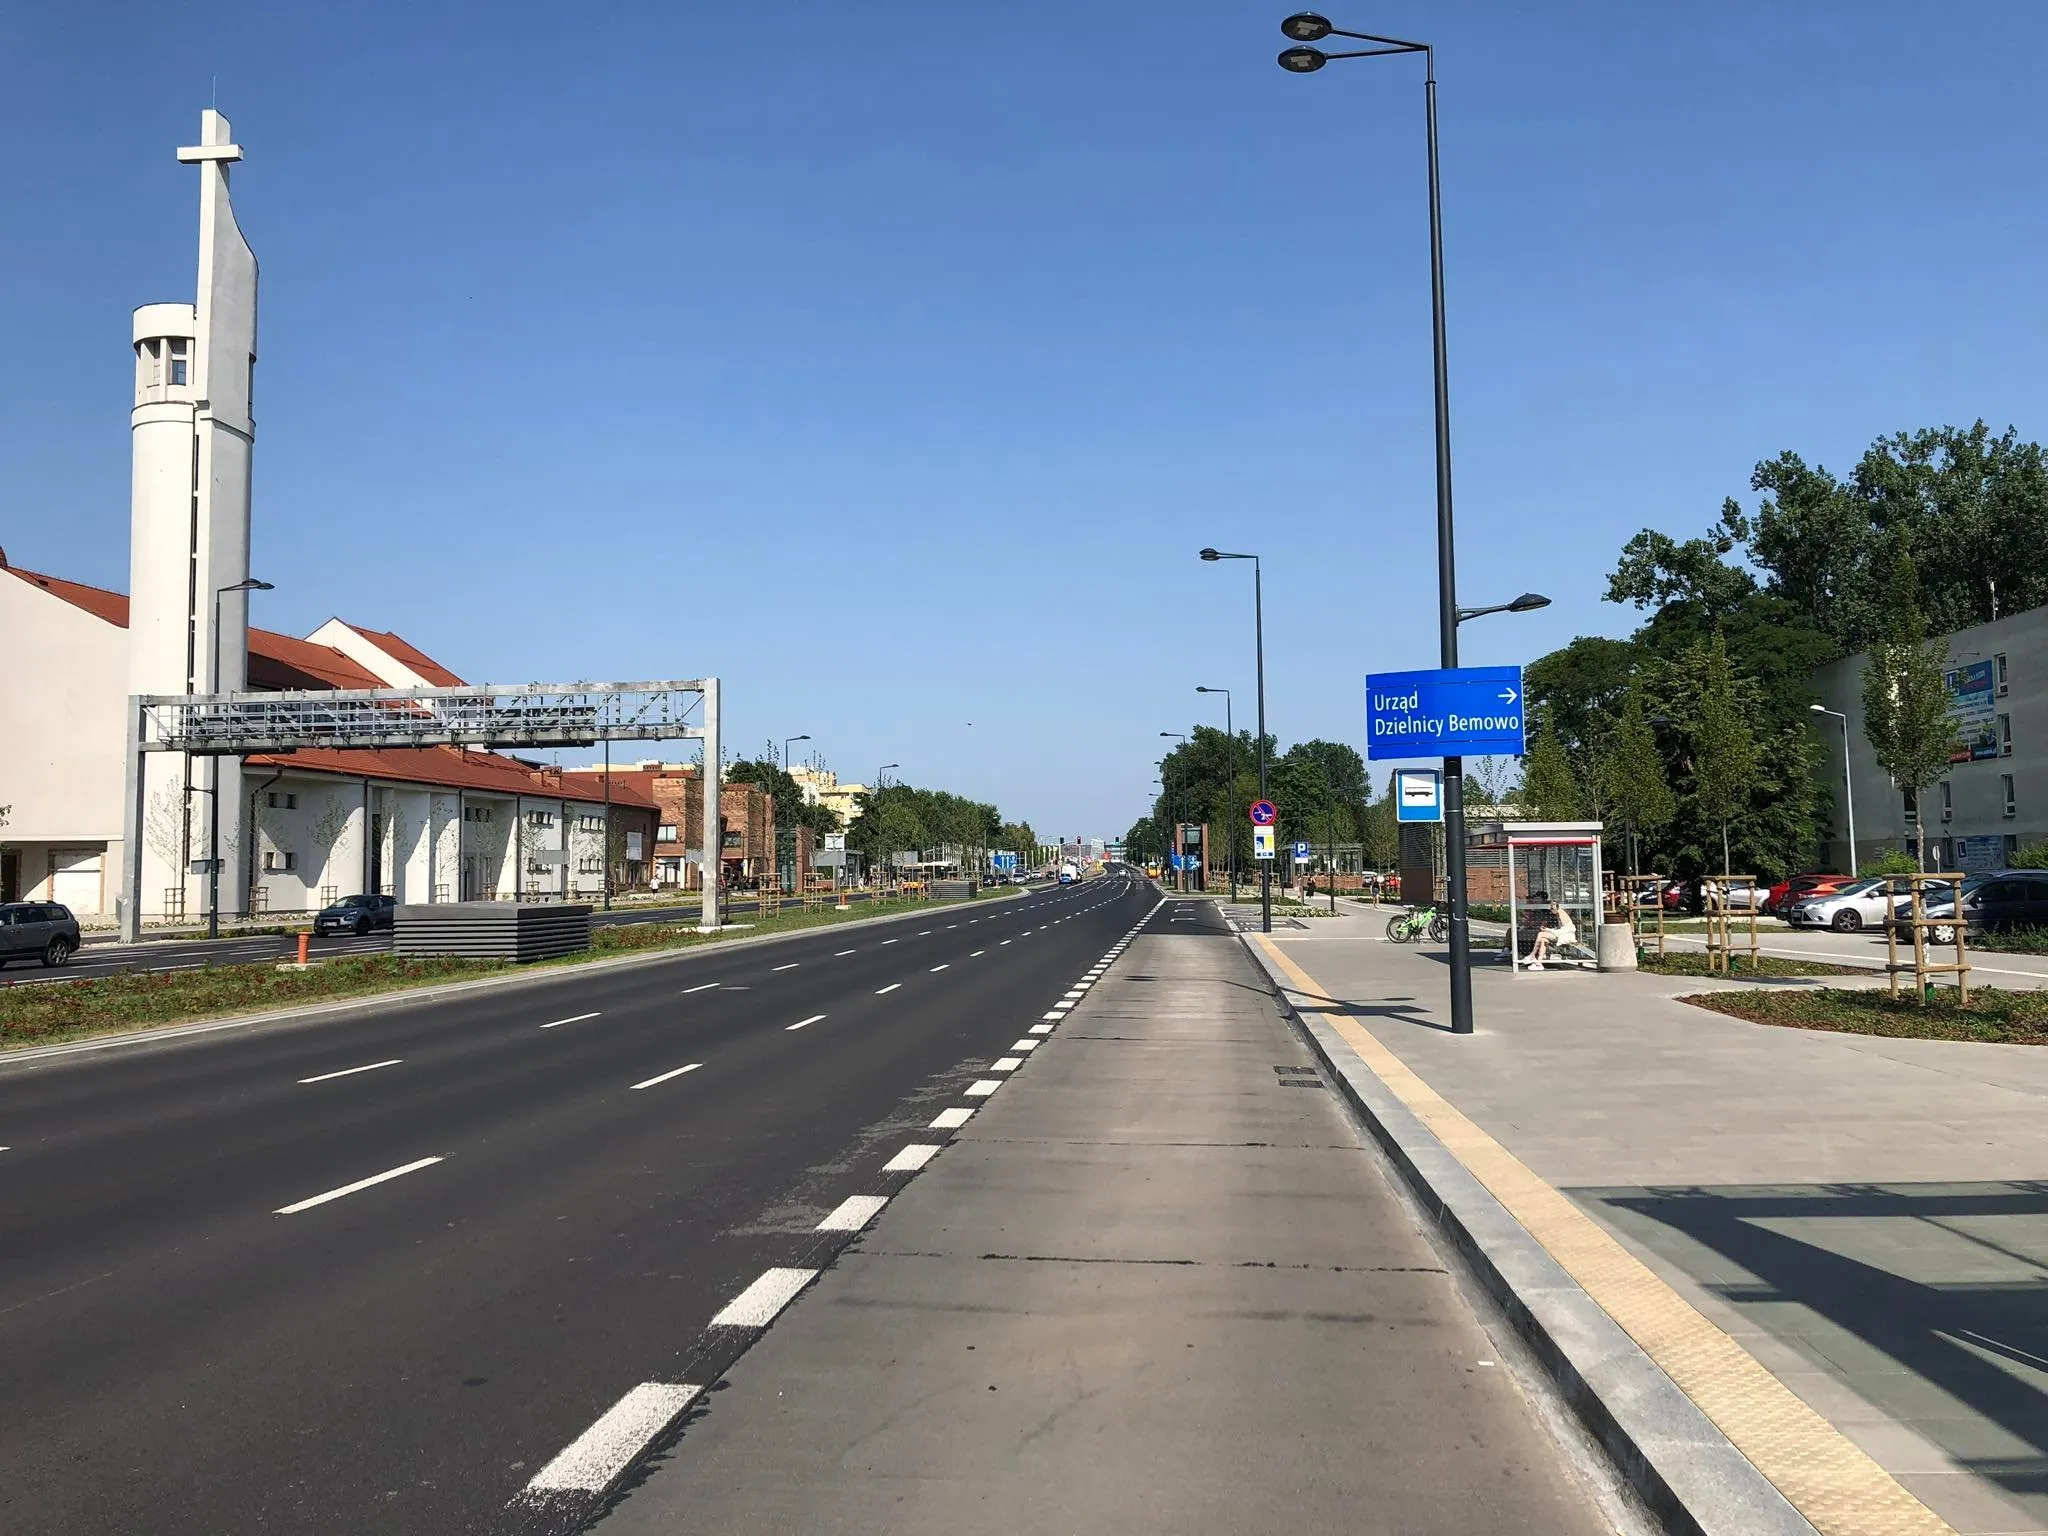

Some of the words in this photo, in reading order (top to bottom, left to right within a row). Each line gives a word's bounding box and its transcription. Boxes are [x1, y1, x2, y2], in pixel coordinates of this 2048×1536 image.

[1374, 690, 1418, 713] Urząd
[1375, 715, 1444, 737] Dzielnicy
[1449, 714, 1519, 732] Bemowo
[1297, 843, 1306, 854] P
